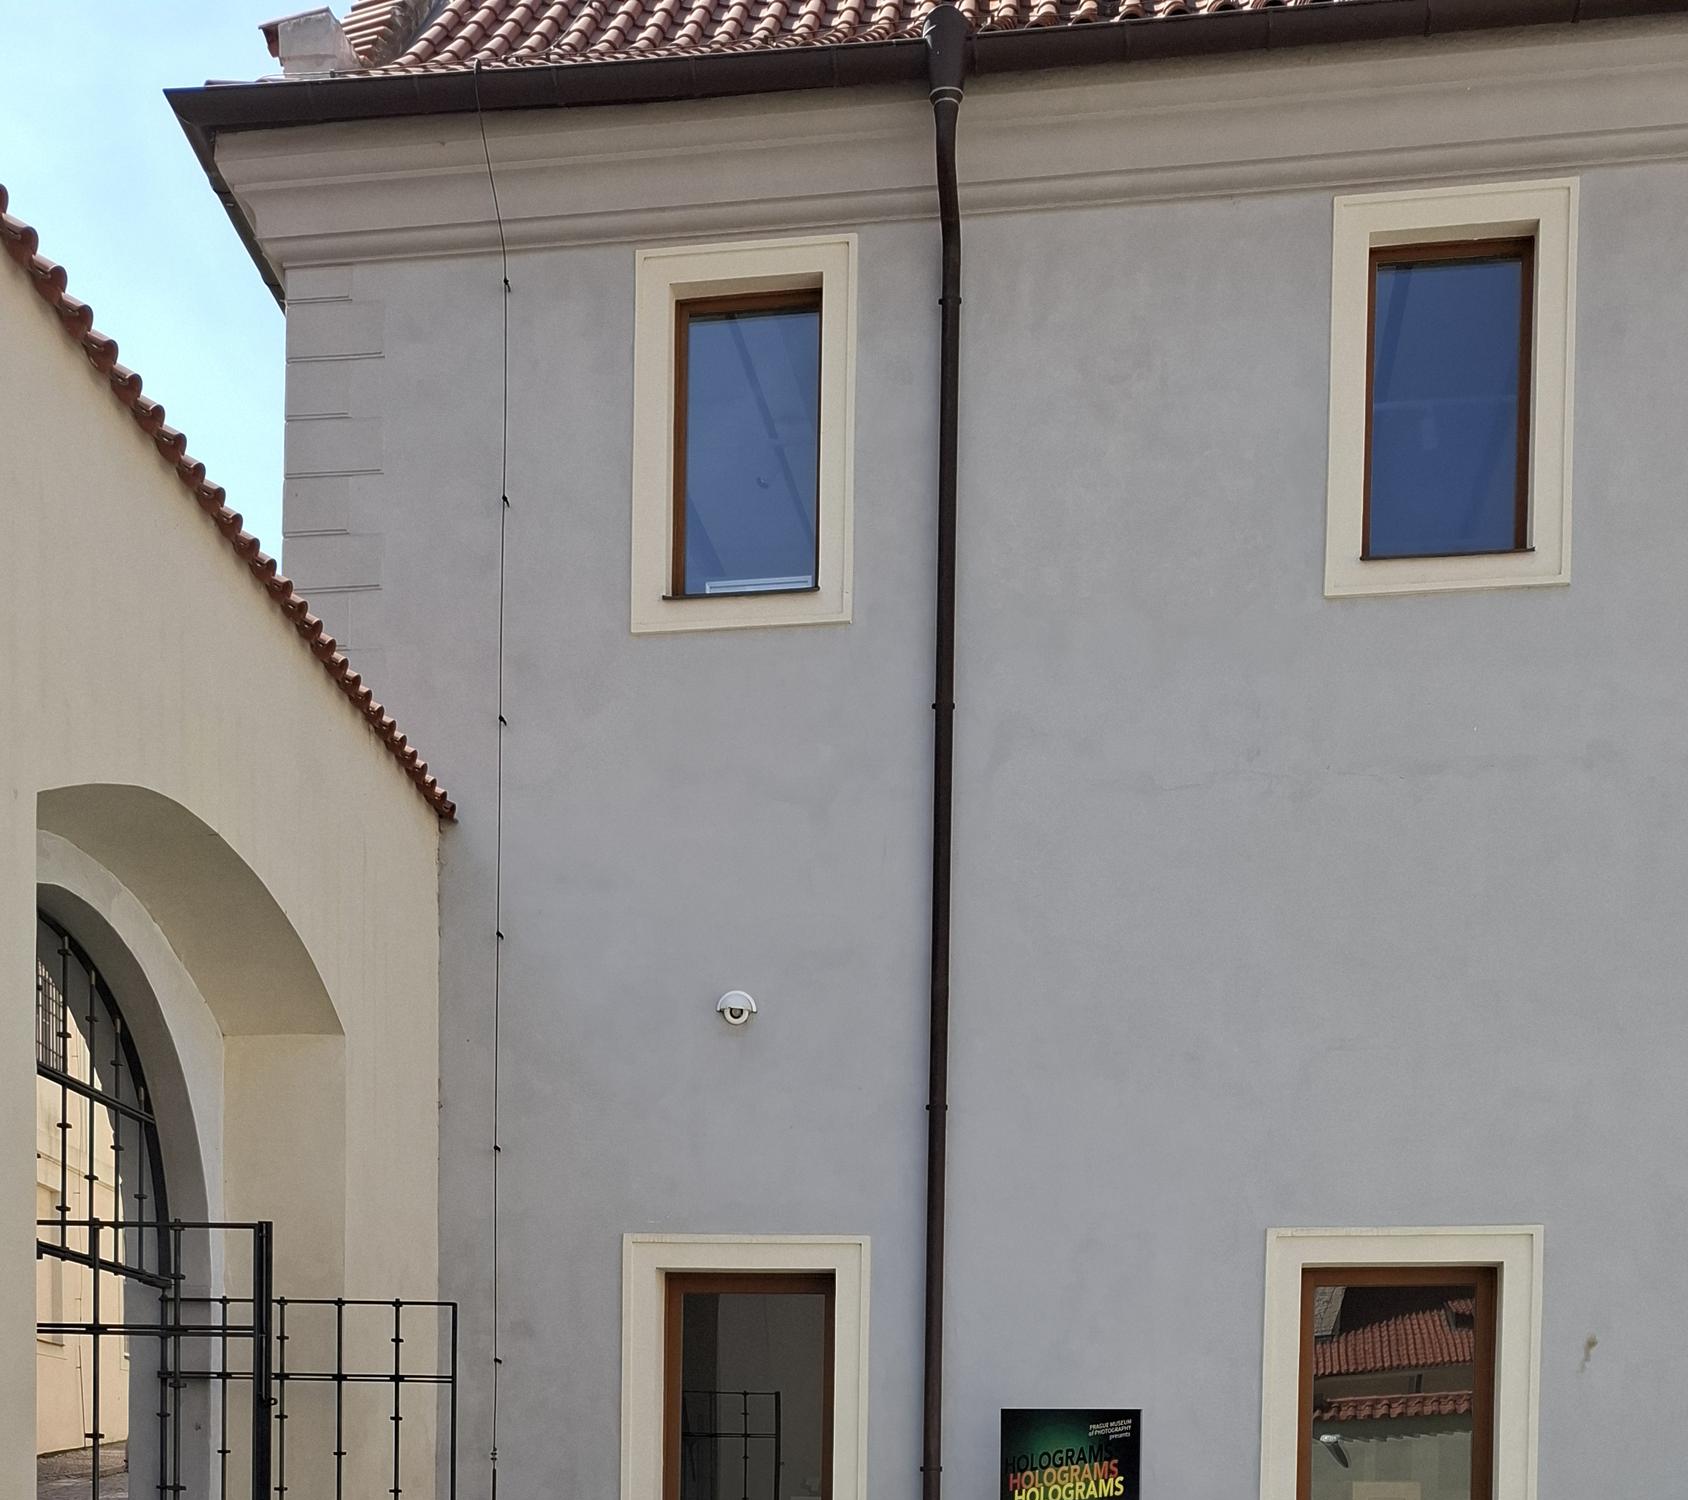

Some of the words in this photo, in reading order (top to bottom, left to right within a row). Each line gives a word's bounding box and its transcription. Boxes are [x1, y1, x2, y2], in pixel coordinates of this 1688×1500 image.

[1094, 1425, 1131, 1436] PHOTOGRAPHY
[1109, 1418, 1132, 1427] MUSEUM
[1006, 1444, 1114, 1474] HOLOGRAMS
[1009, 1459, 1119, 1491] HOLOGRAMS
